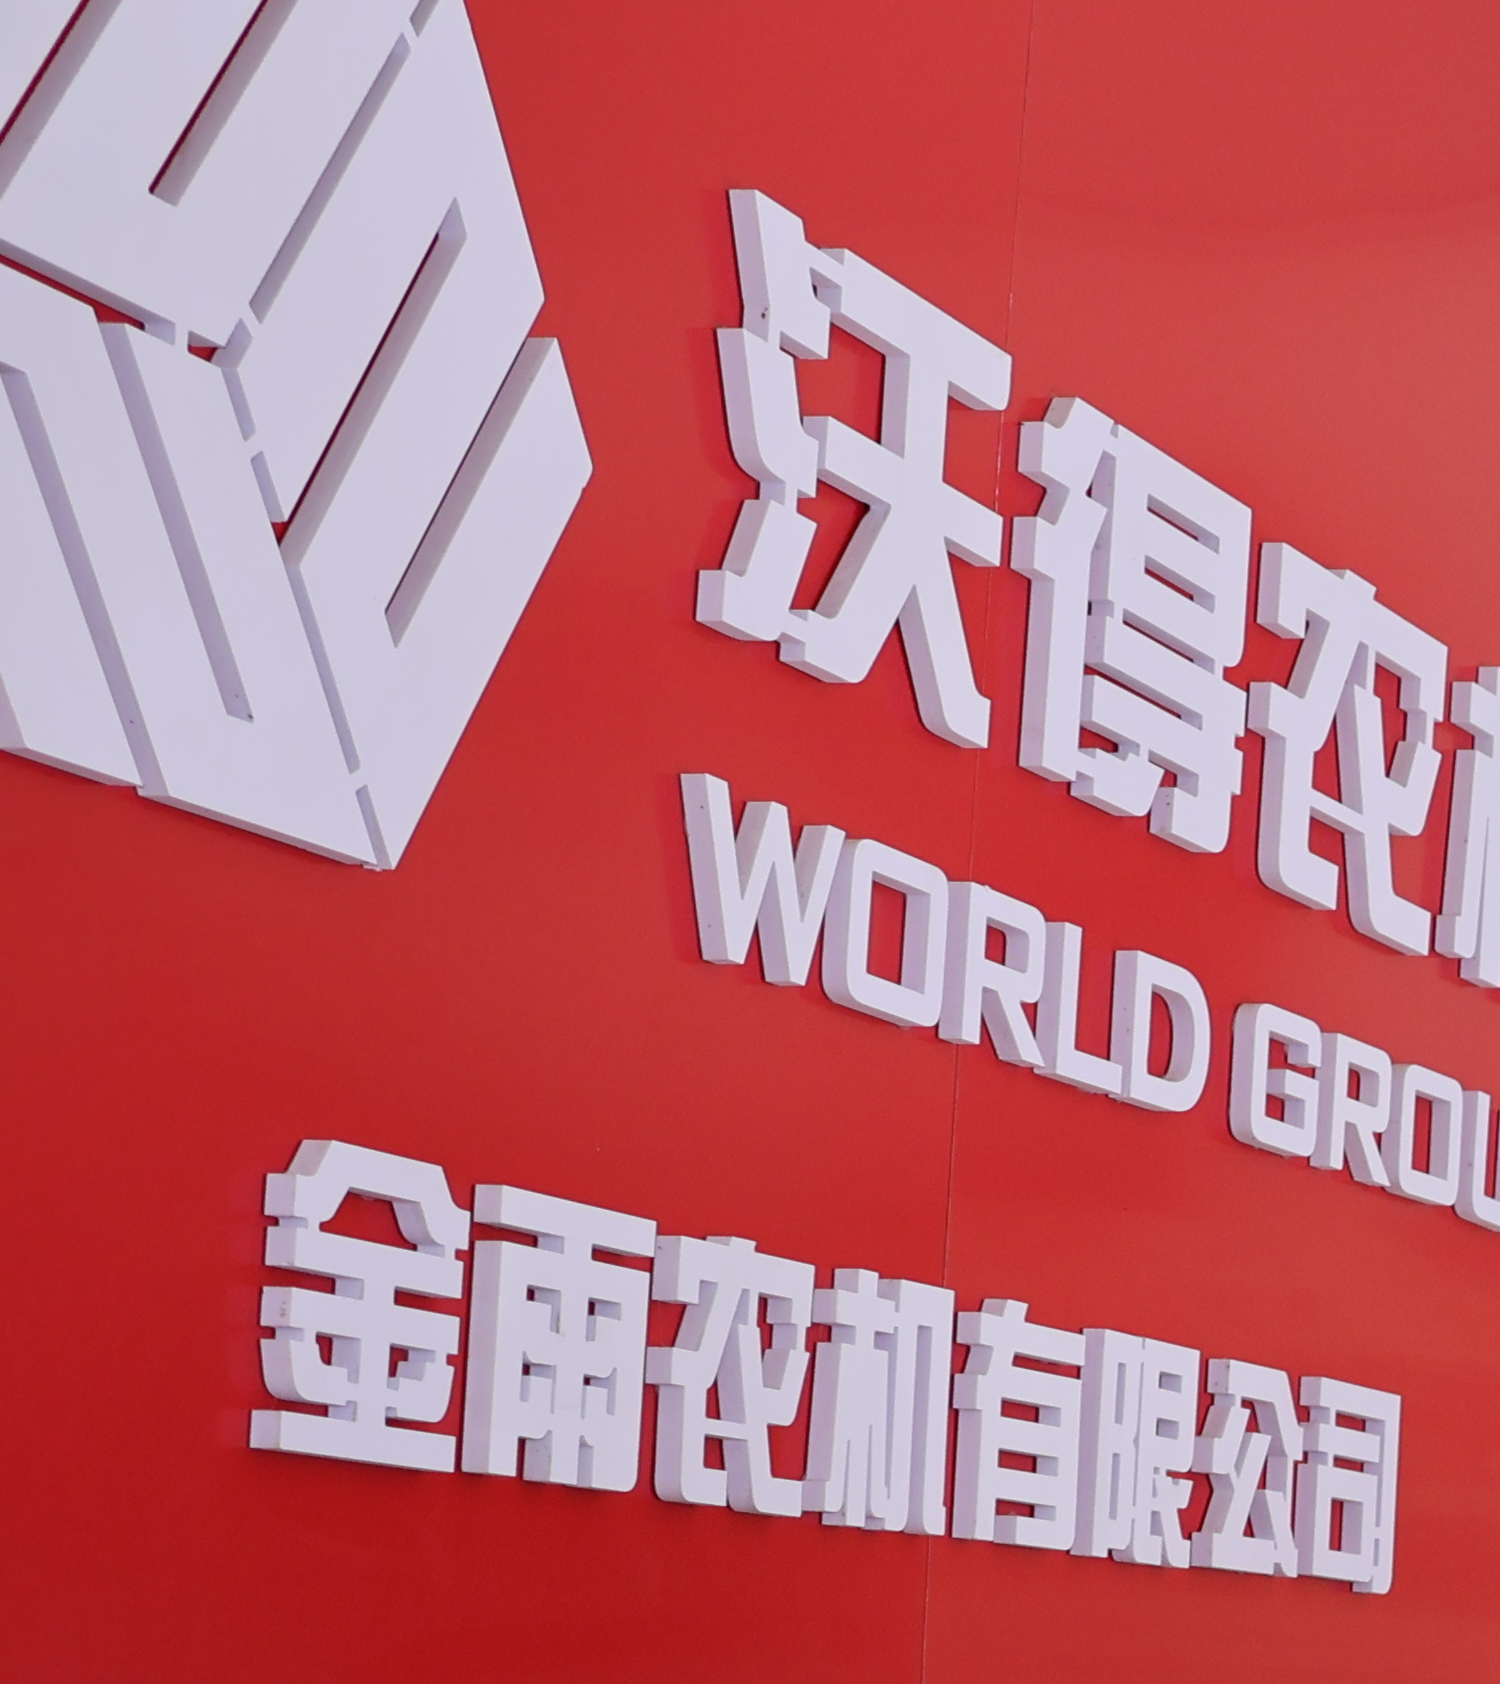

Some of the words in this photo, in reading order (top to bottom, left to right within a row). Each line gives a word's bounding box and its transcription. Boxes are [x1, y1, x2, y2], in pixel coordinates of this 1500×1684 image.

[680, 772, 1212, 1113] WORLD
[249, 1138, 1402, 1595] 金雨农机有限公司
